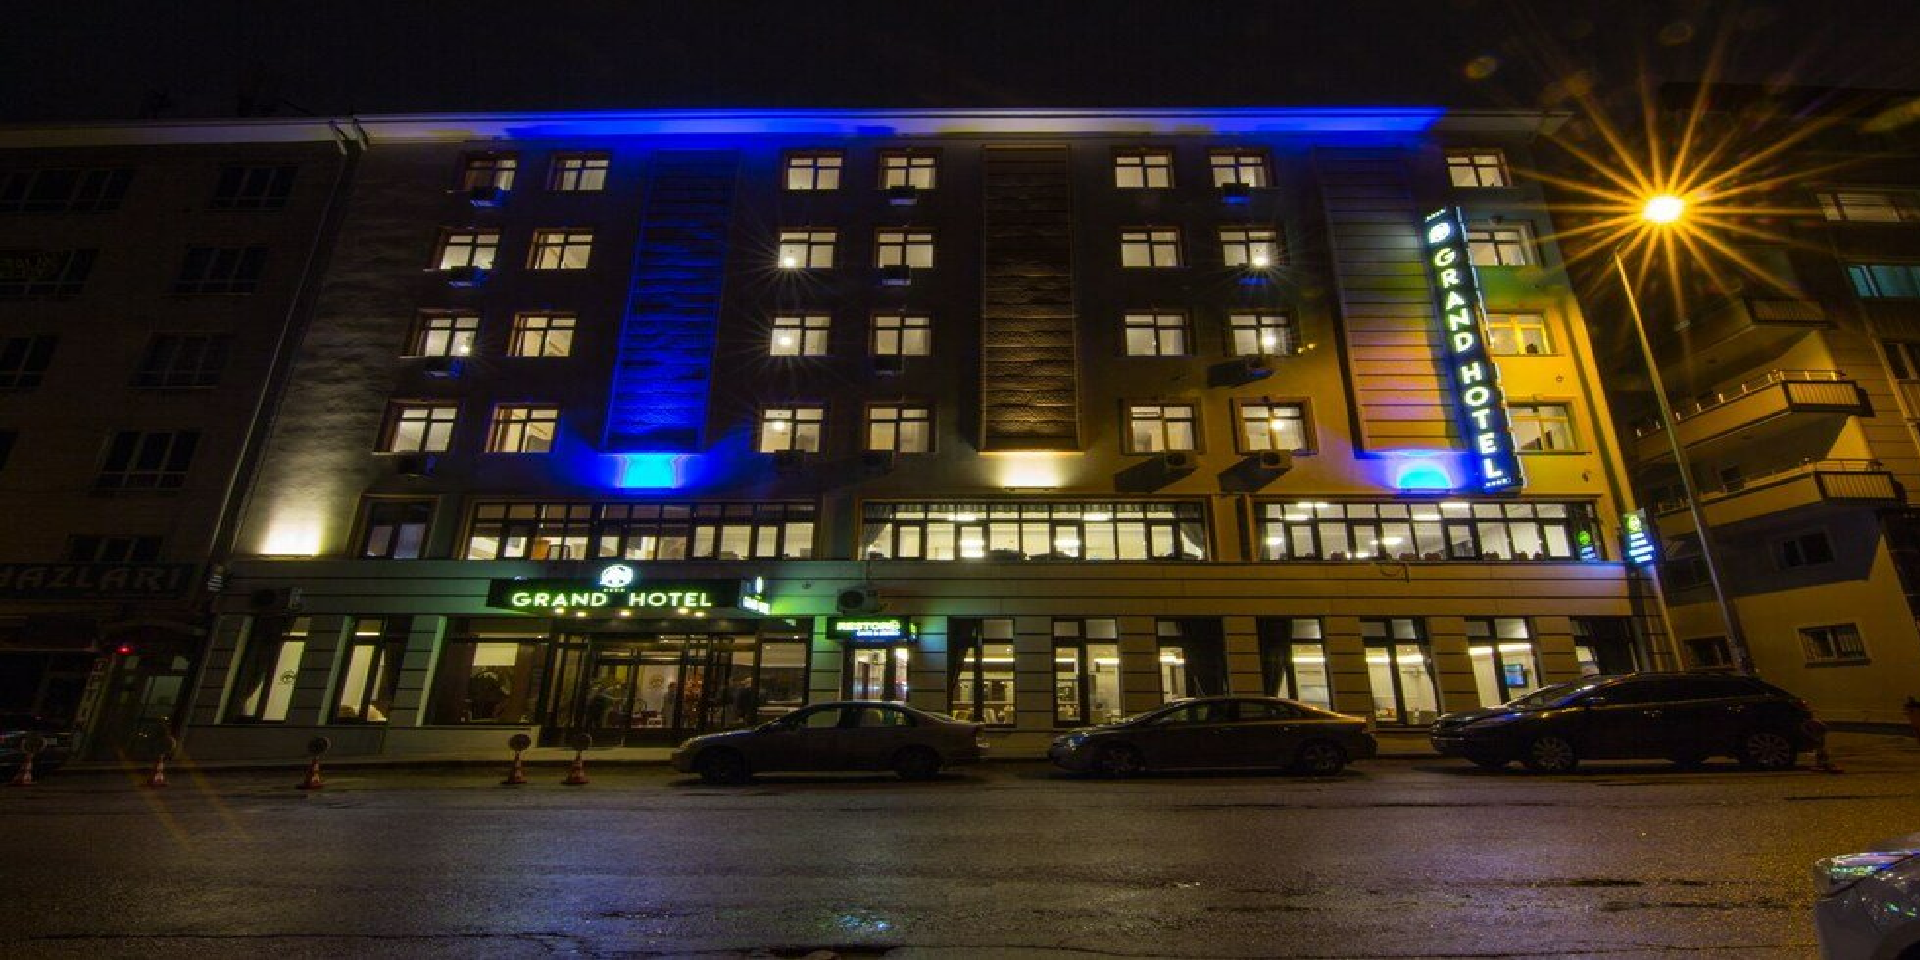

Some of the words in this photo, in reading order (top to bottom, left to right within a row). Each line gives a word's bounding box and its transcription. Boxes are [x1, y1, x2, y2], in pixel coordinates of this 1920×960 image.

[1433, 247, 1475, 353] GRAND
[1461, 362, 1504, 479] HOTEL
[511, 592, 608, 607] GRAND
[628, 592, 713, 607] HOTEL
